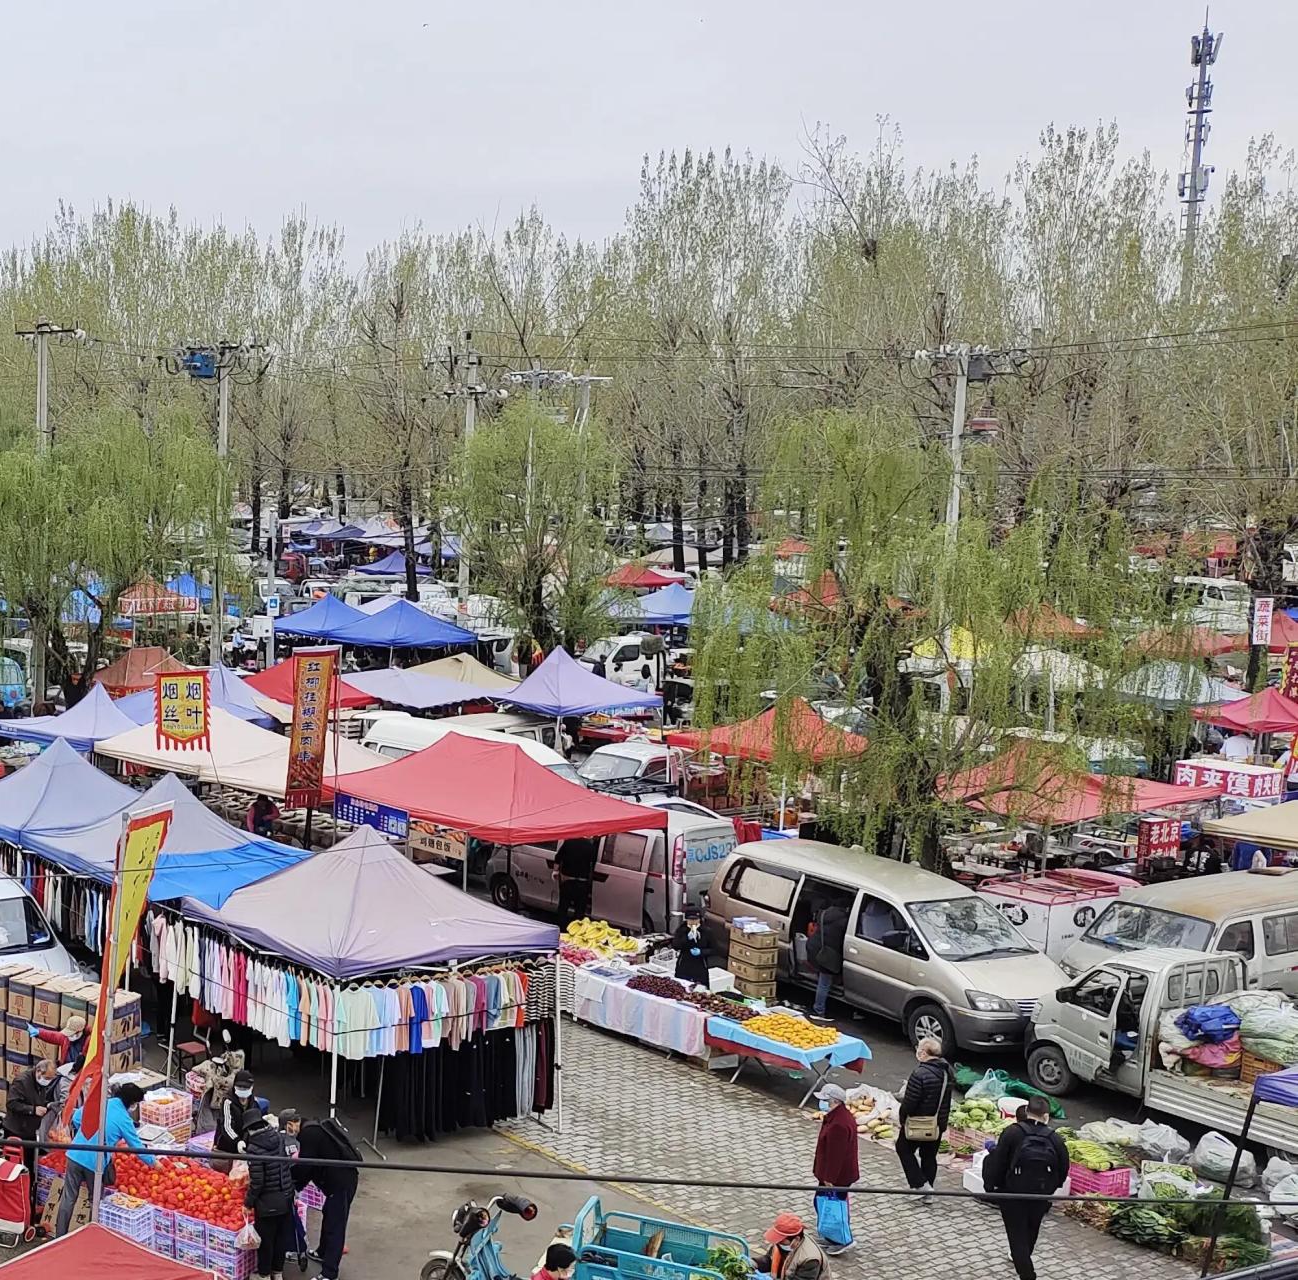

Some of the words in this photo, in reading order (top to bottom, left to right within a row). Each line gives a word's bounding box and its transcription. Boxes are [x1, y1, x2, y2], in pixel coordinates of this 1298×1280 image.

[1256, 601, 1270, 642] 蔬菜街
[162, 682, 179, 722] 烟丝
[186, 682, 203, 724] 烟叶
[1176, 766, 1251, 797] 肉夹馍
[1254, 773, 1282, 797] 肉夹馍
[1150, 821, 1180, 845] 老北京
